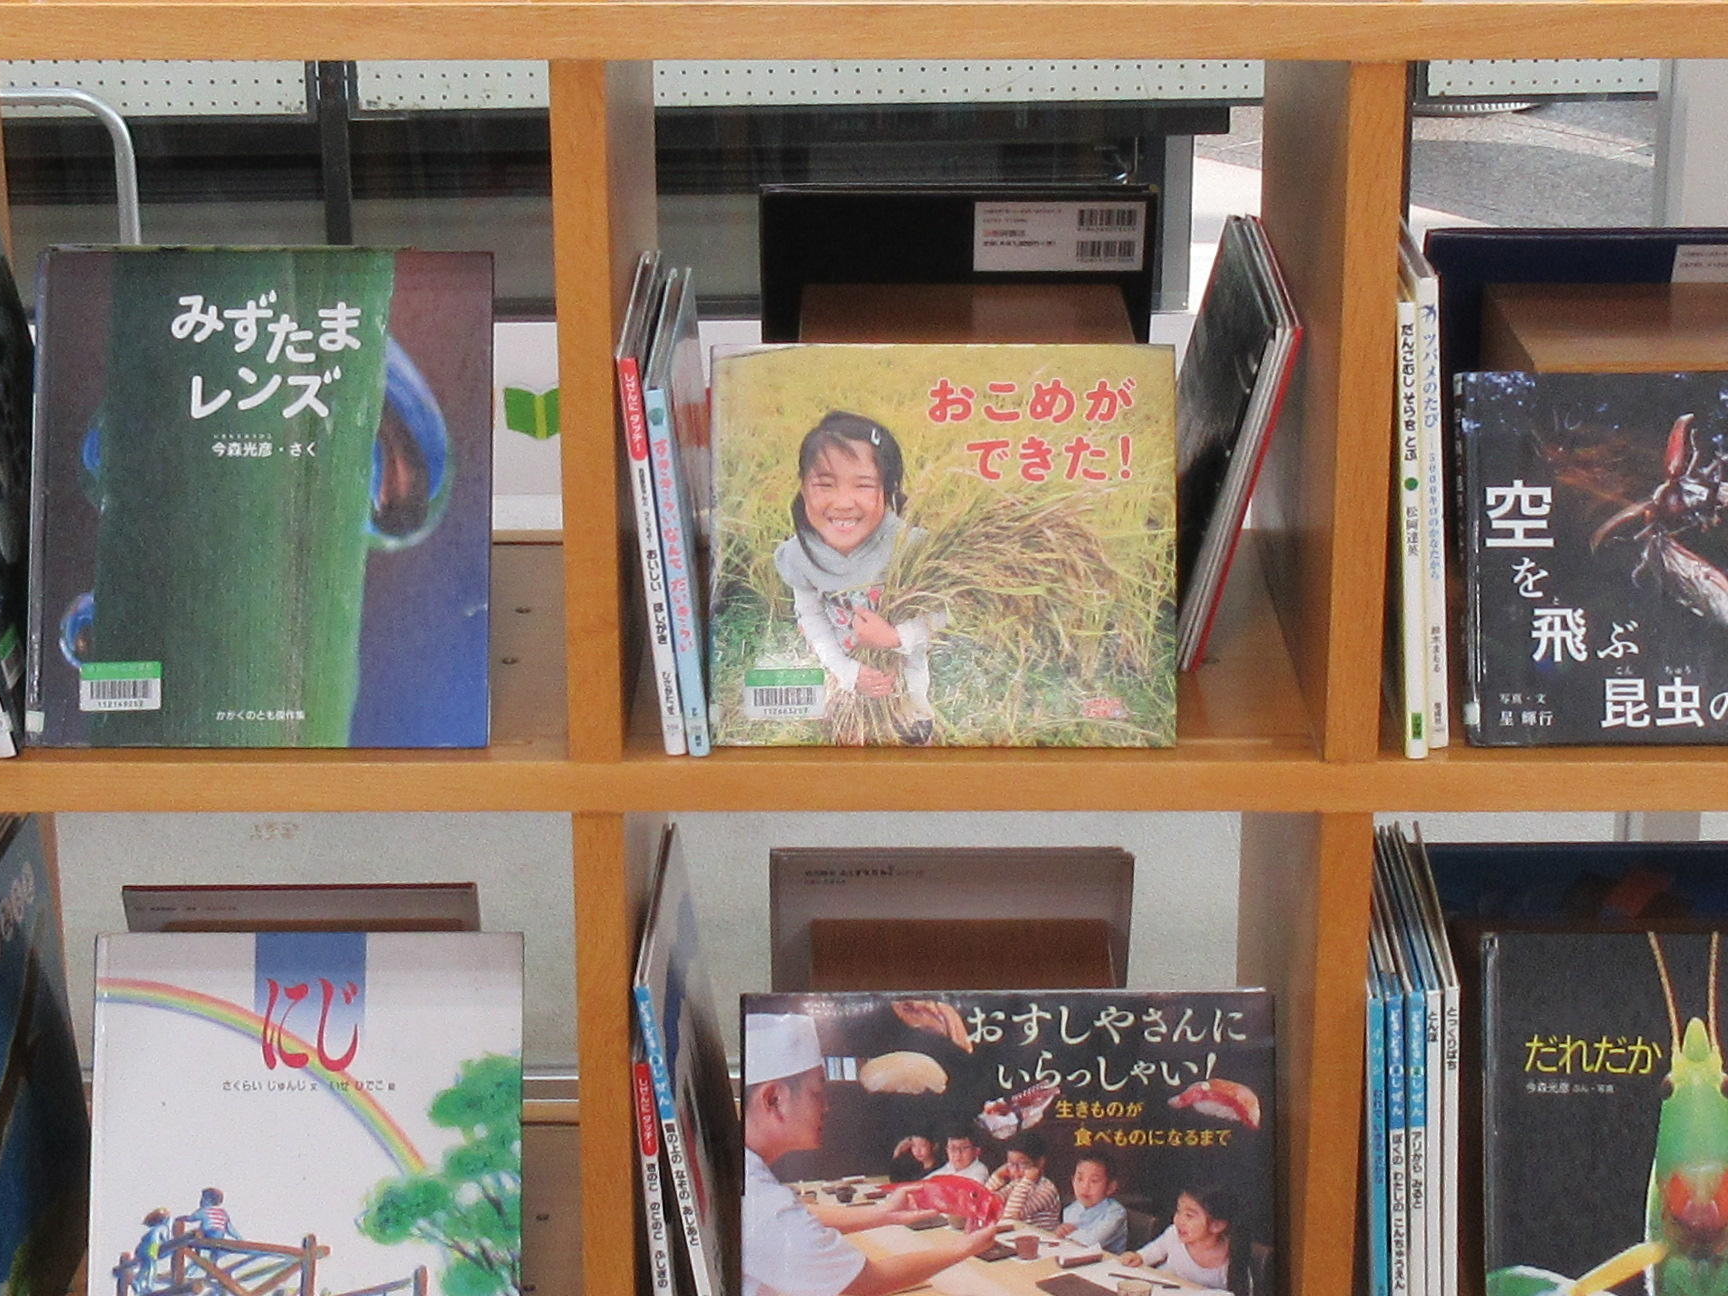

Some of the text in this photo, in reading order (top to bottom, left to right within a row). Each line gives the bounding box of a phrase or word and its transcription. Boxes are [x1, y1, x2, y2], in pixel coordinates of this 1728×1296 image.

[171, 289, 362, 364] みずたま
[190, 365, 342, 419] レンズ
[927, 378, 1136, 424] おこめが
[1421, 331, 1438, 430] ツバメのたび
[966, 434, 1133, 483] できた!
[261, 977, 360, 1073] にじ
[966, 1006, 1248, 1045] おすしやさんに
[1426, 1009, 1439, 1045] とんぼ
[1446, 1005, 1459, 1073] とっくりばち
[997, 1052, 1219, 1092] いらっしゃい!
[1524, 1034, 1662, 1075] だれだか
[222, 1079, 263, 1092] さくらい
[266, 1079, 307, 1093] じゅんじ
[1056, 1099, 1144, 1120] 生きものが
[1074, 1127, 1232, 1149] 食べものになるまで
